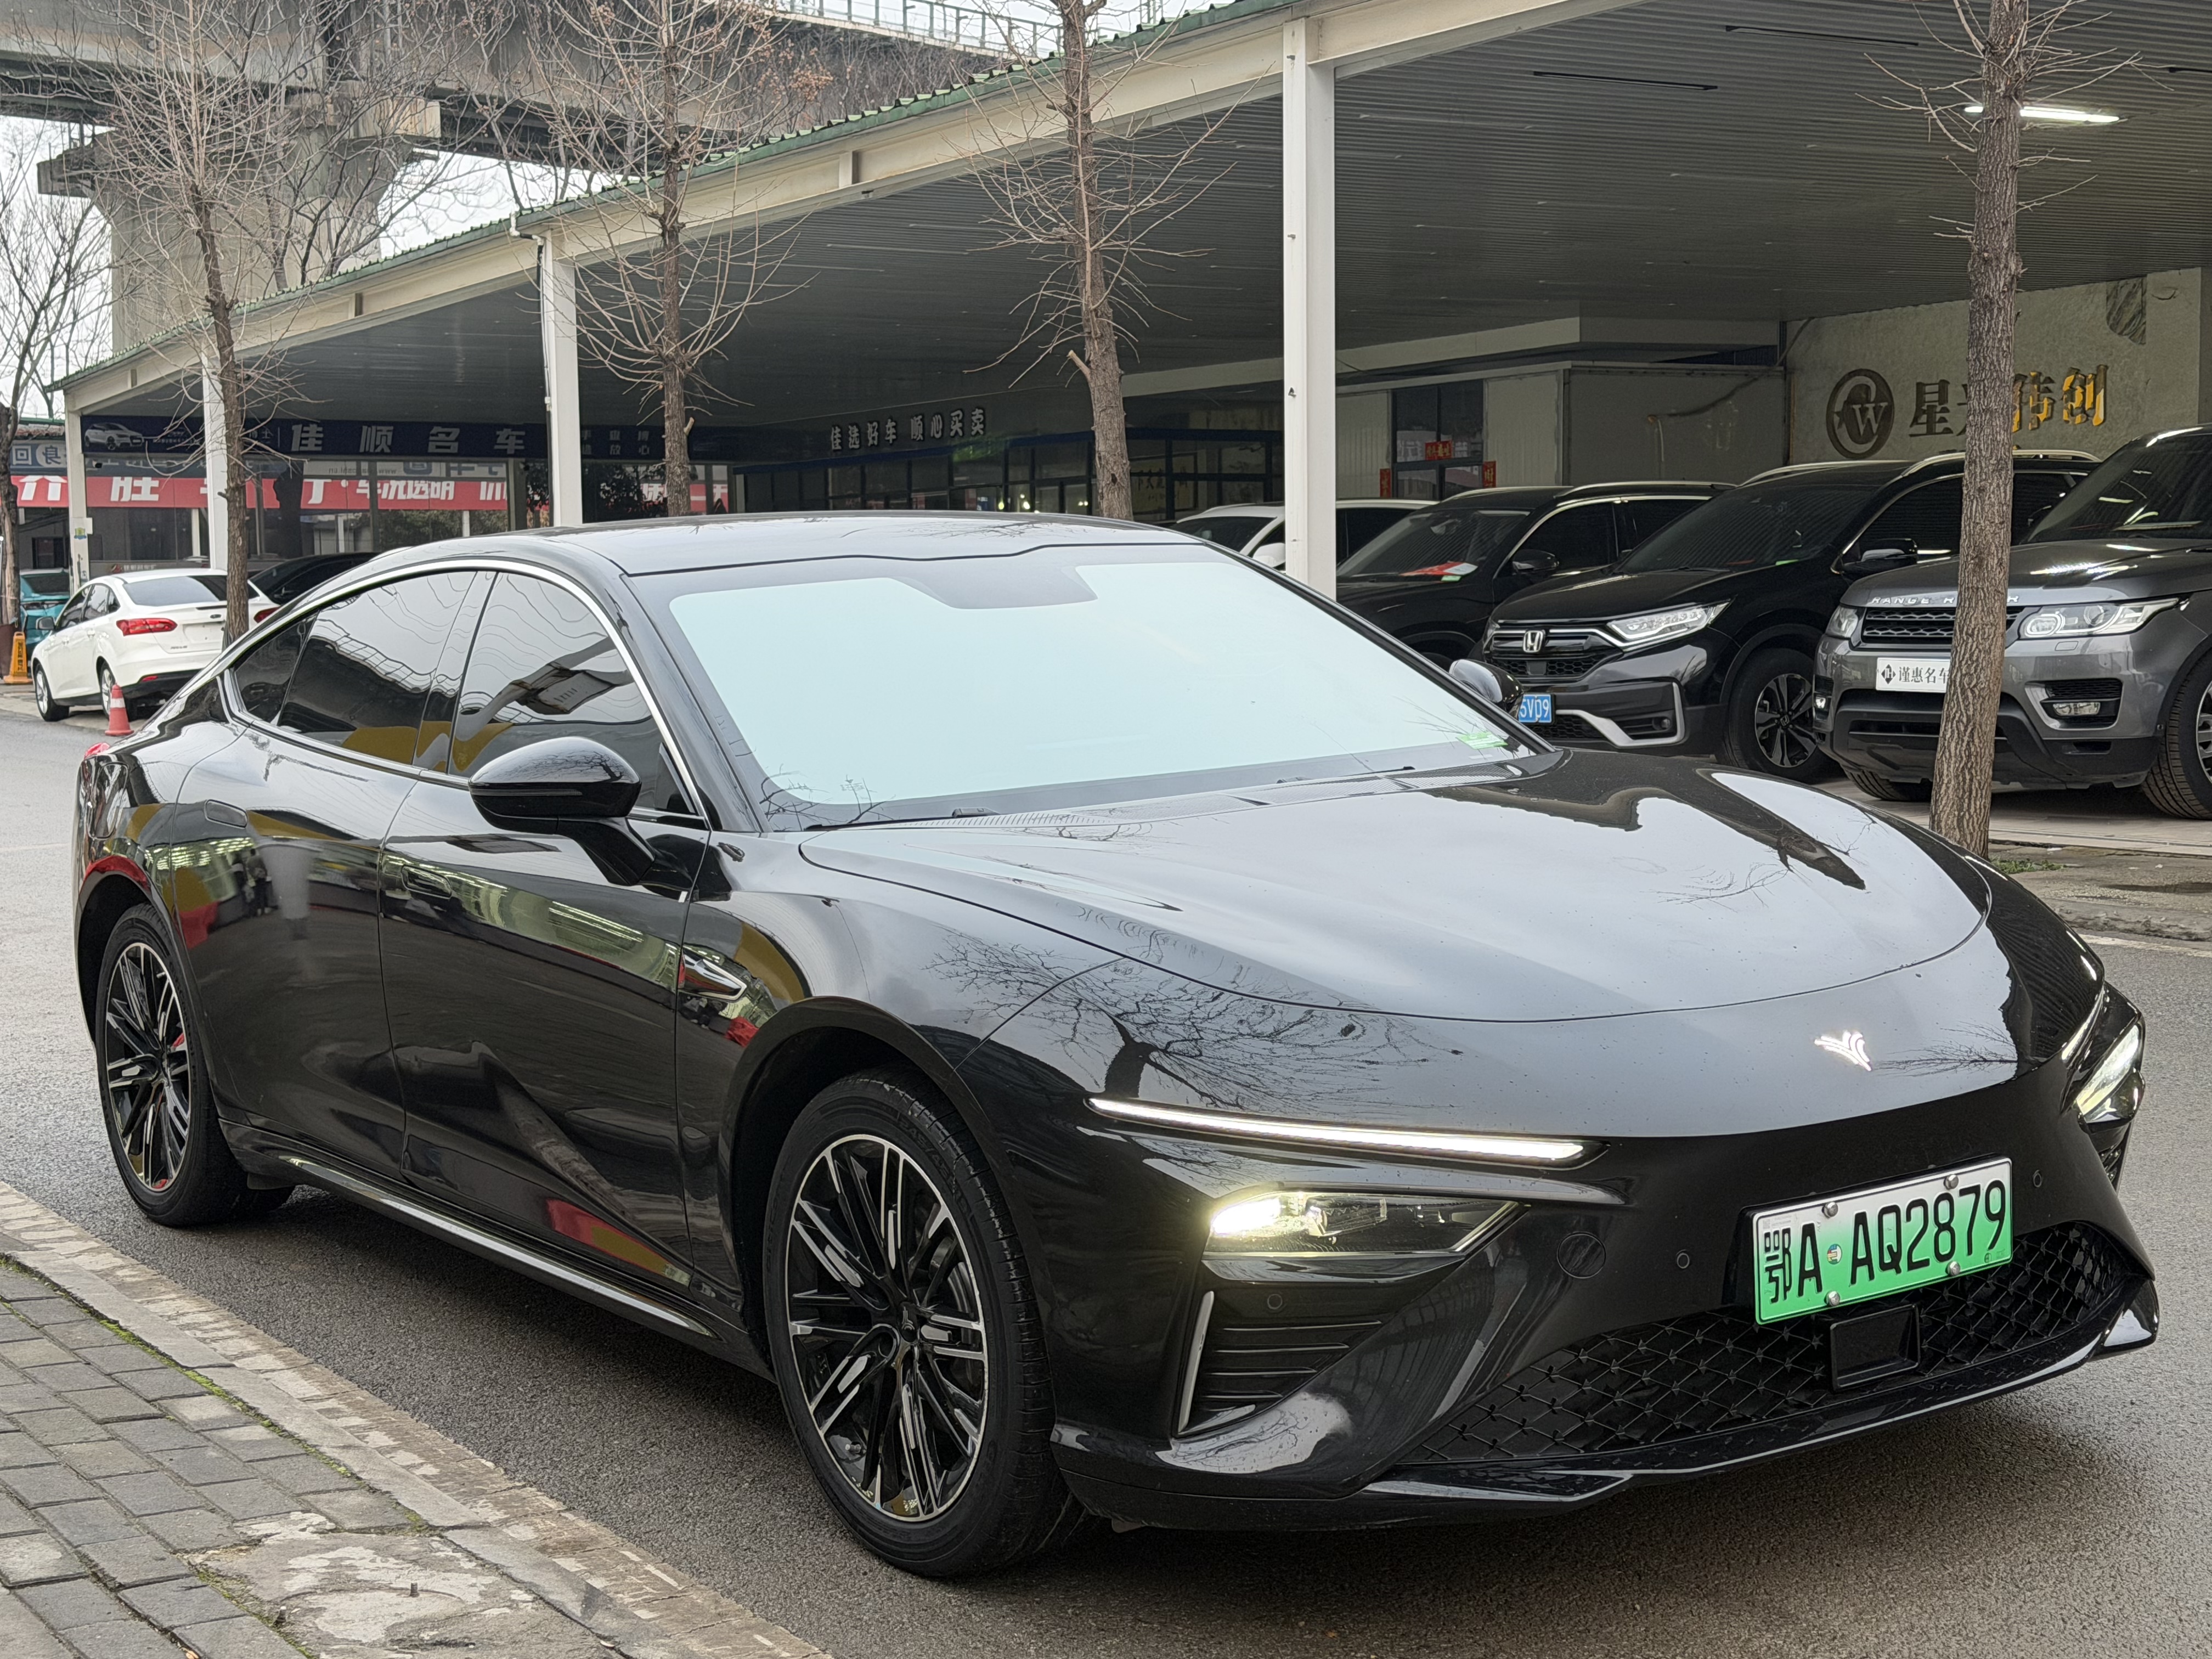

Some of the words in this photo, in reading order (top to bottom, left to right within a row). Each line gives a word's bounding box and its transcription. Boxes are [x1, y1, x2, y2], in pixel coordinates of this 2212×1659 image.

[1909, 364, 2108, 437] 星伟创
[291, 424, 526, 455] 佳顺名车
[1850, 1179, 2006, 1285] AQ2879
